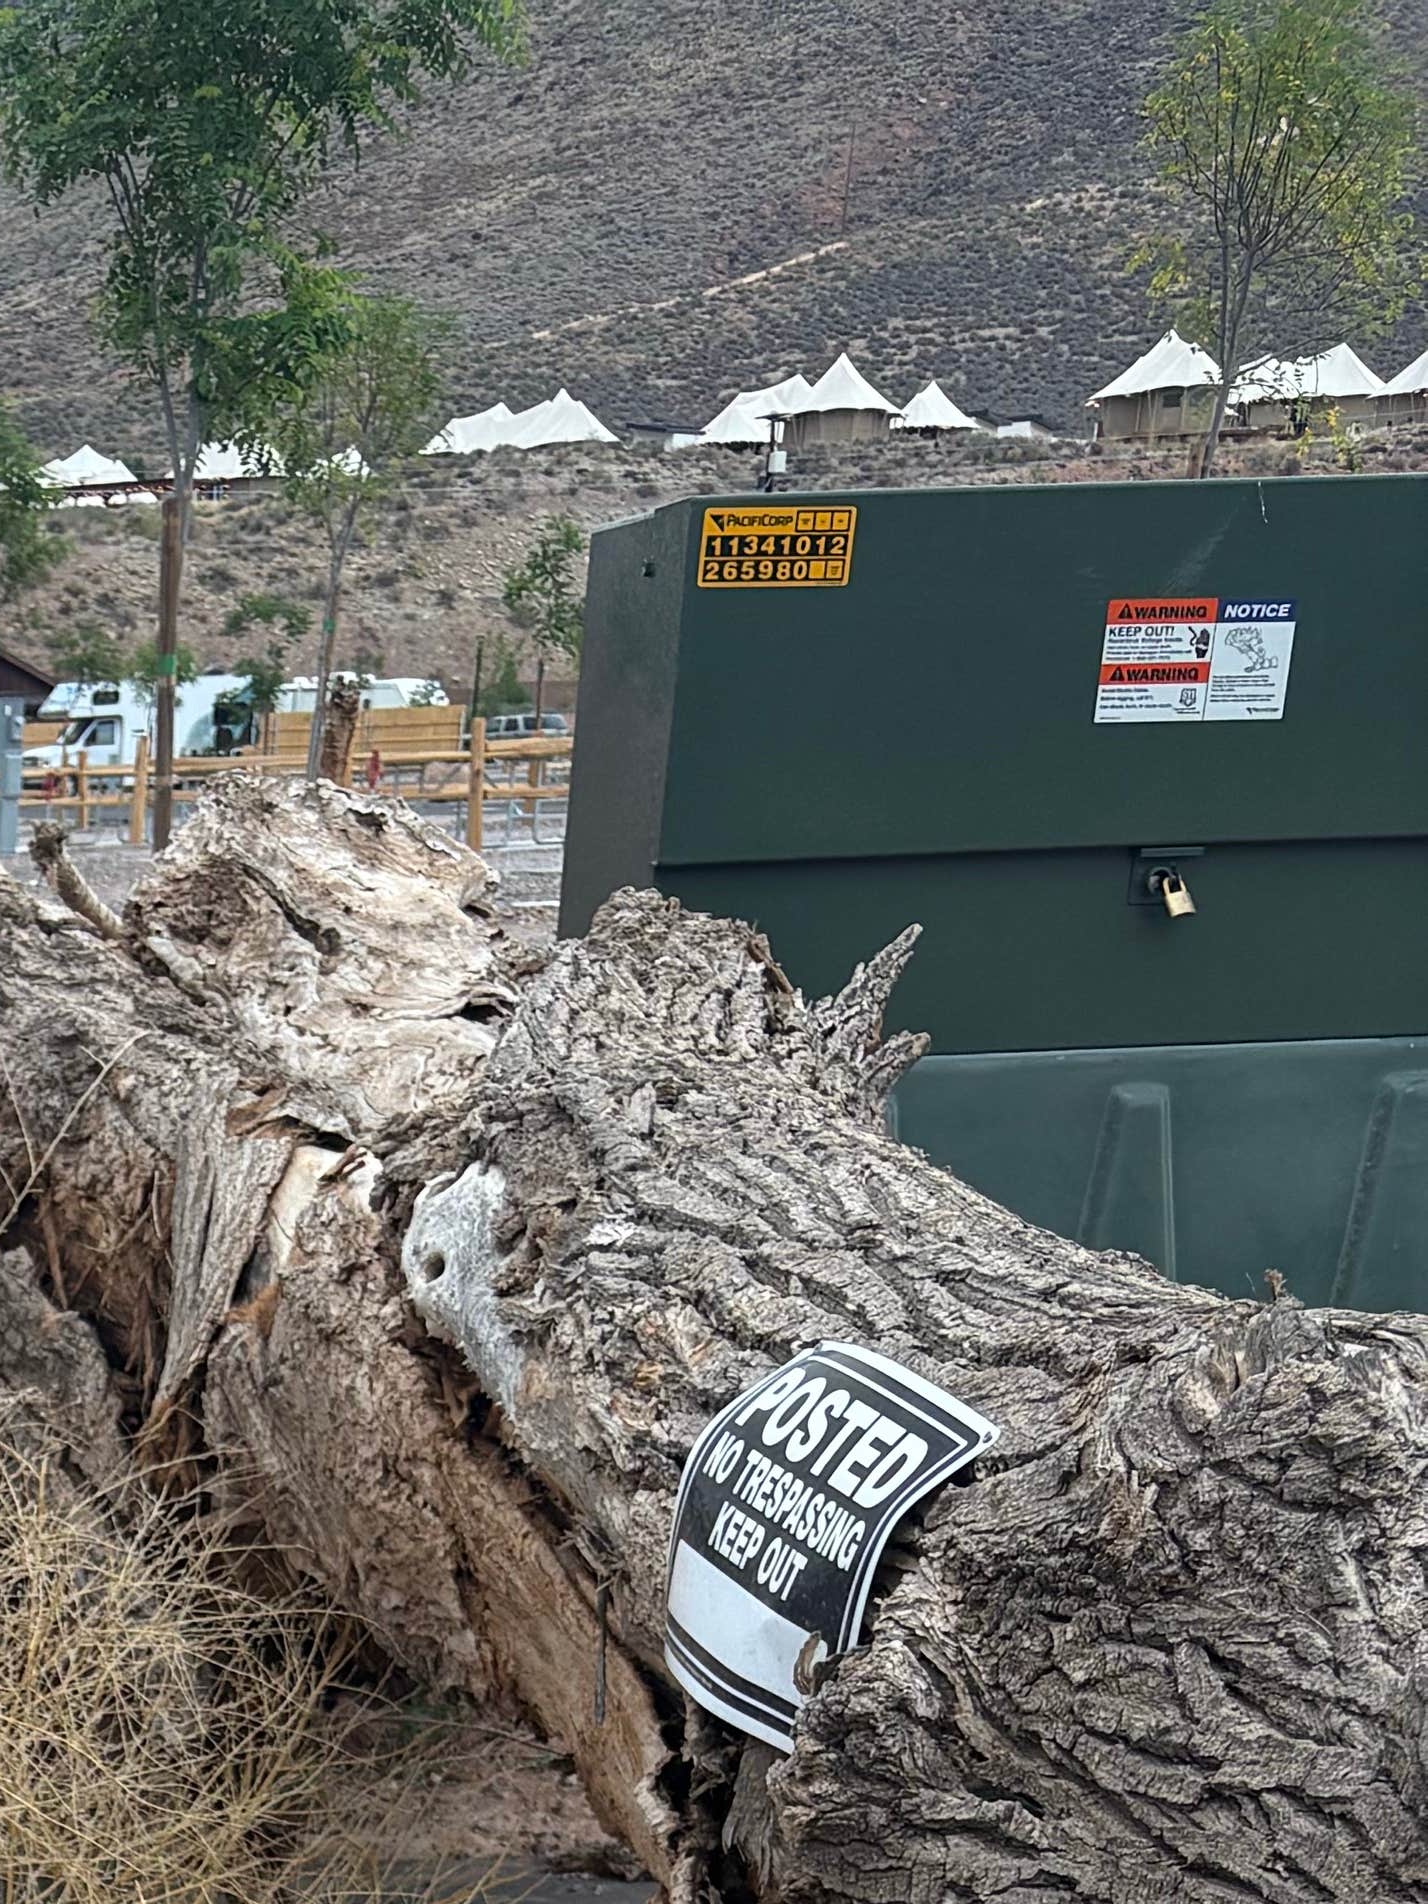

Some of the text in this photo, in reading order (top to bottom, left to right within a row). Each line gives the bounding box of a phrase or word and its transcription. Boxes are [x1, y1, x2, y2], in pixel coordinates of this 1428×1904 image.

[711, 536, 845, 556] 11341012
[705, 562, 807, 580] 265980
[1134, 606, 1207, 619] WARNING
[1225, 603, 1290, 618] NOTICE
[1109, 626, 1174, 637] KEEP OUT!
[1127, 668, 1199, 681] WARNING
[736, 1367, 928, 1509] POSTED
[703, 1431, 866, 1572] NO TRESPASSING
[707, 1501, 807, 1601] KEEP OUT
